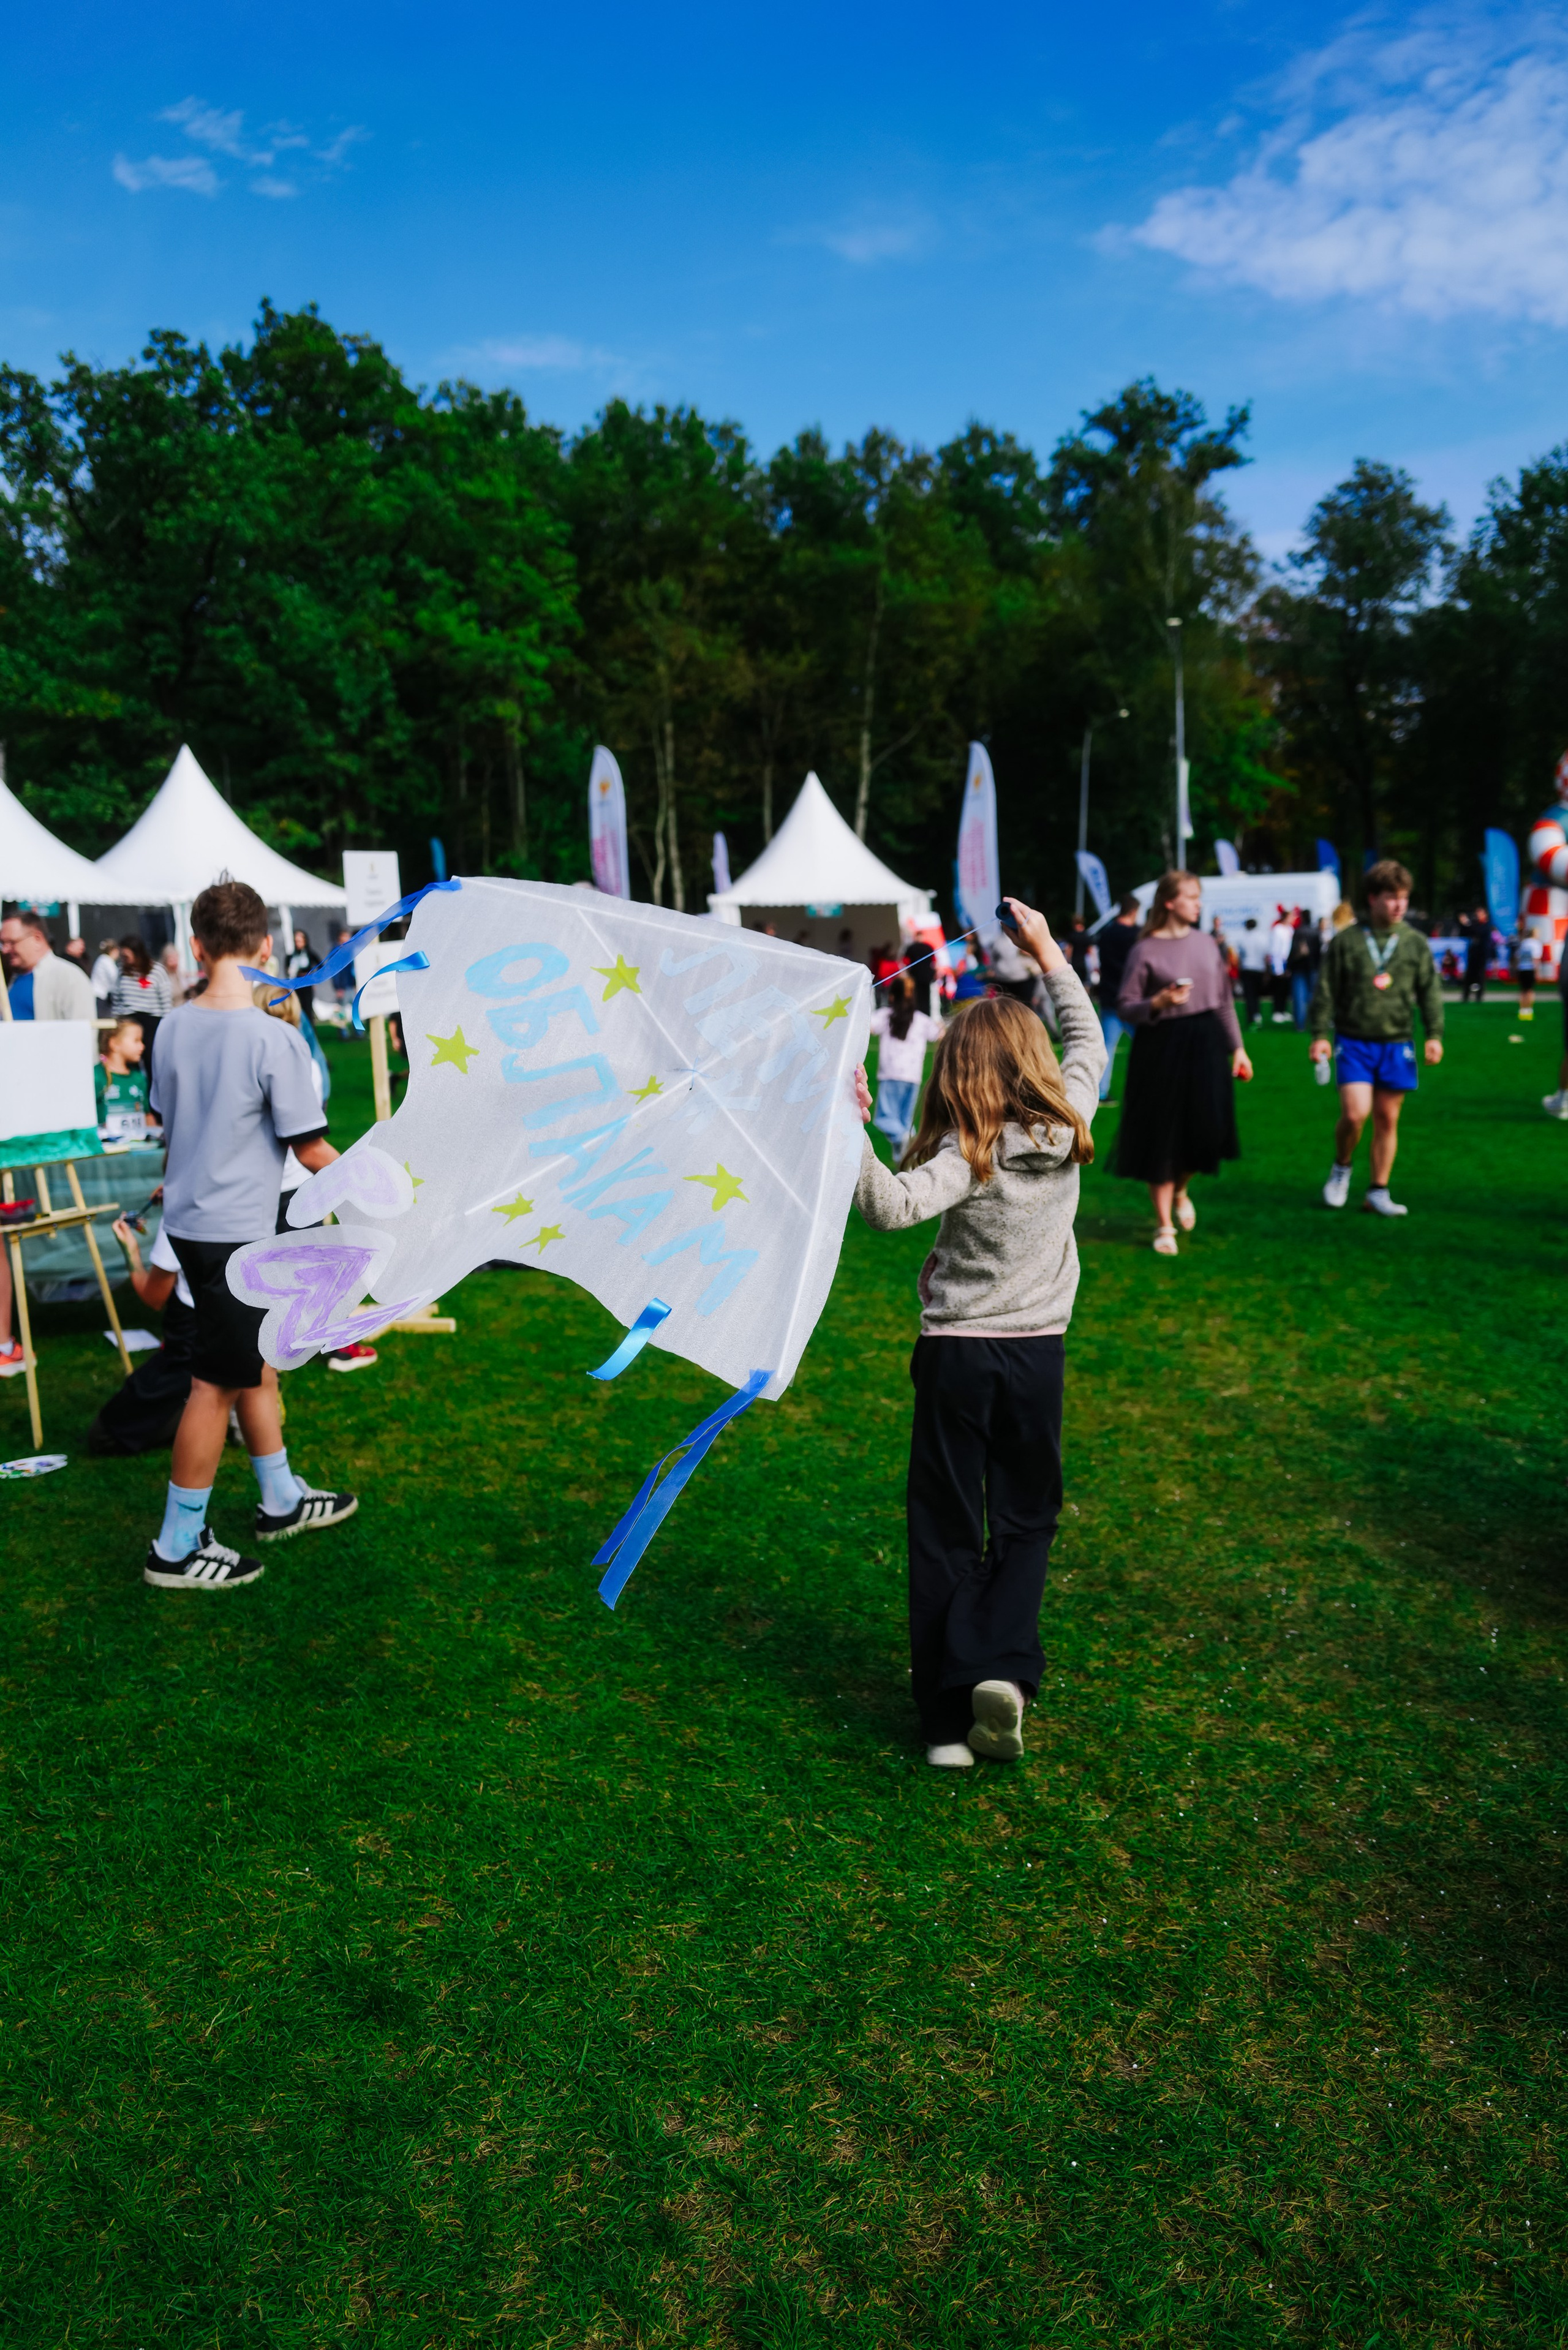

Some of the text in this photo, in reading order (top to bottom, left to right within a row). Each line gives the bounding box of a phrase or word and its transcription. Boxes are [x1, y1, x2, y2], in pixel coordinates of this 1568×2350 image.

[465, 942, 759, 1317] ОБЛАКАМ
[659, 935, 865, 1170] ЛЕТИМ
[666, 1068, 762, 1135] К
